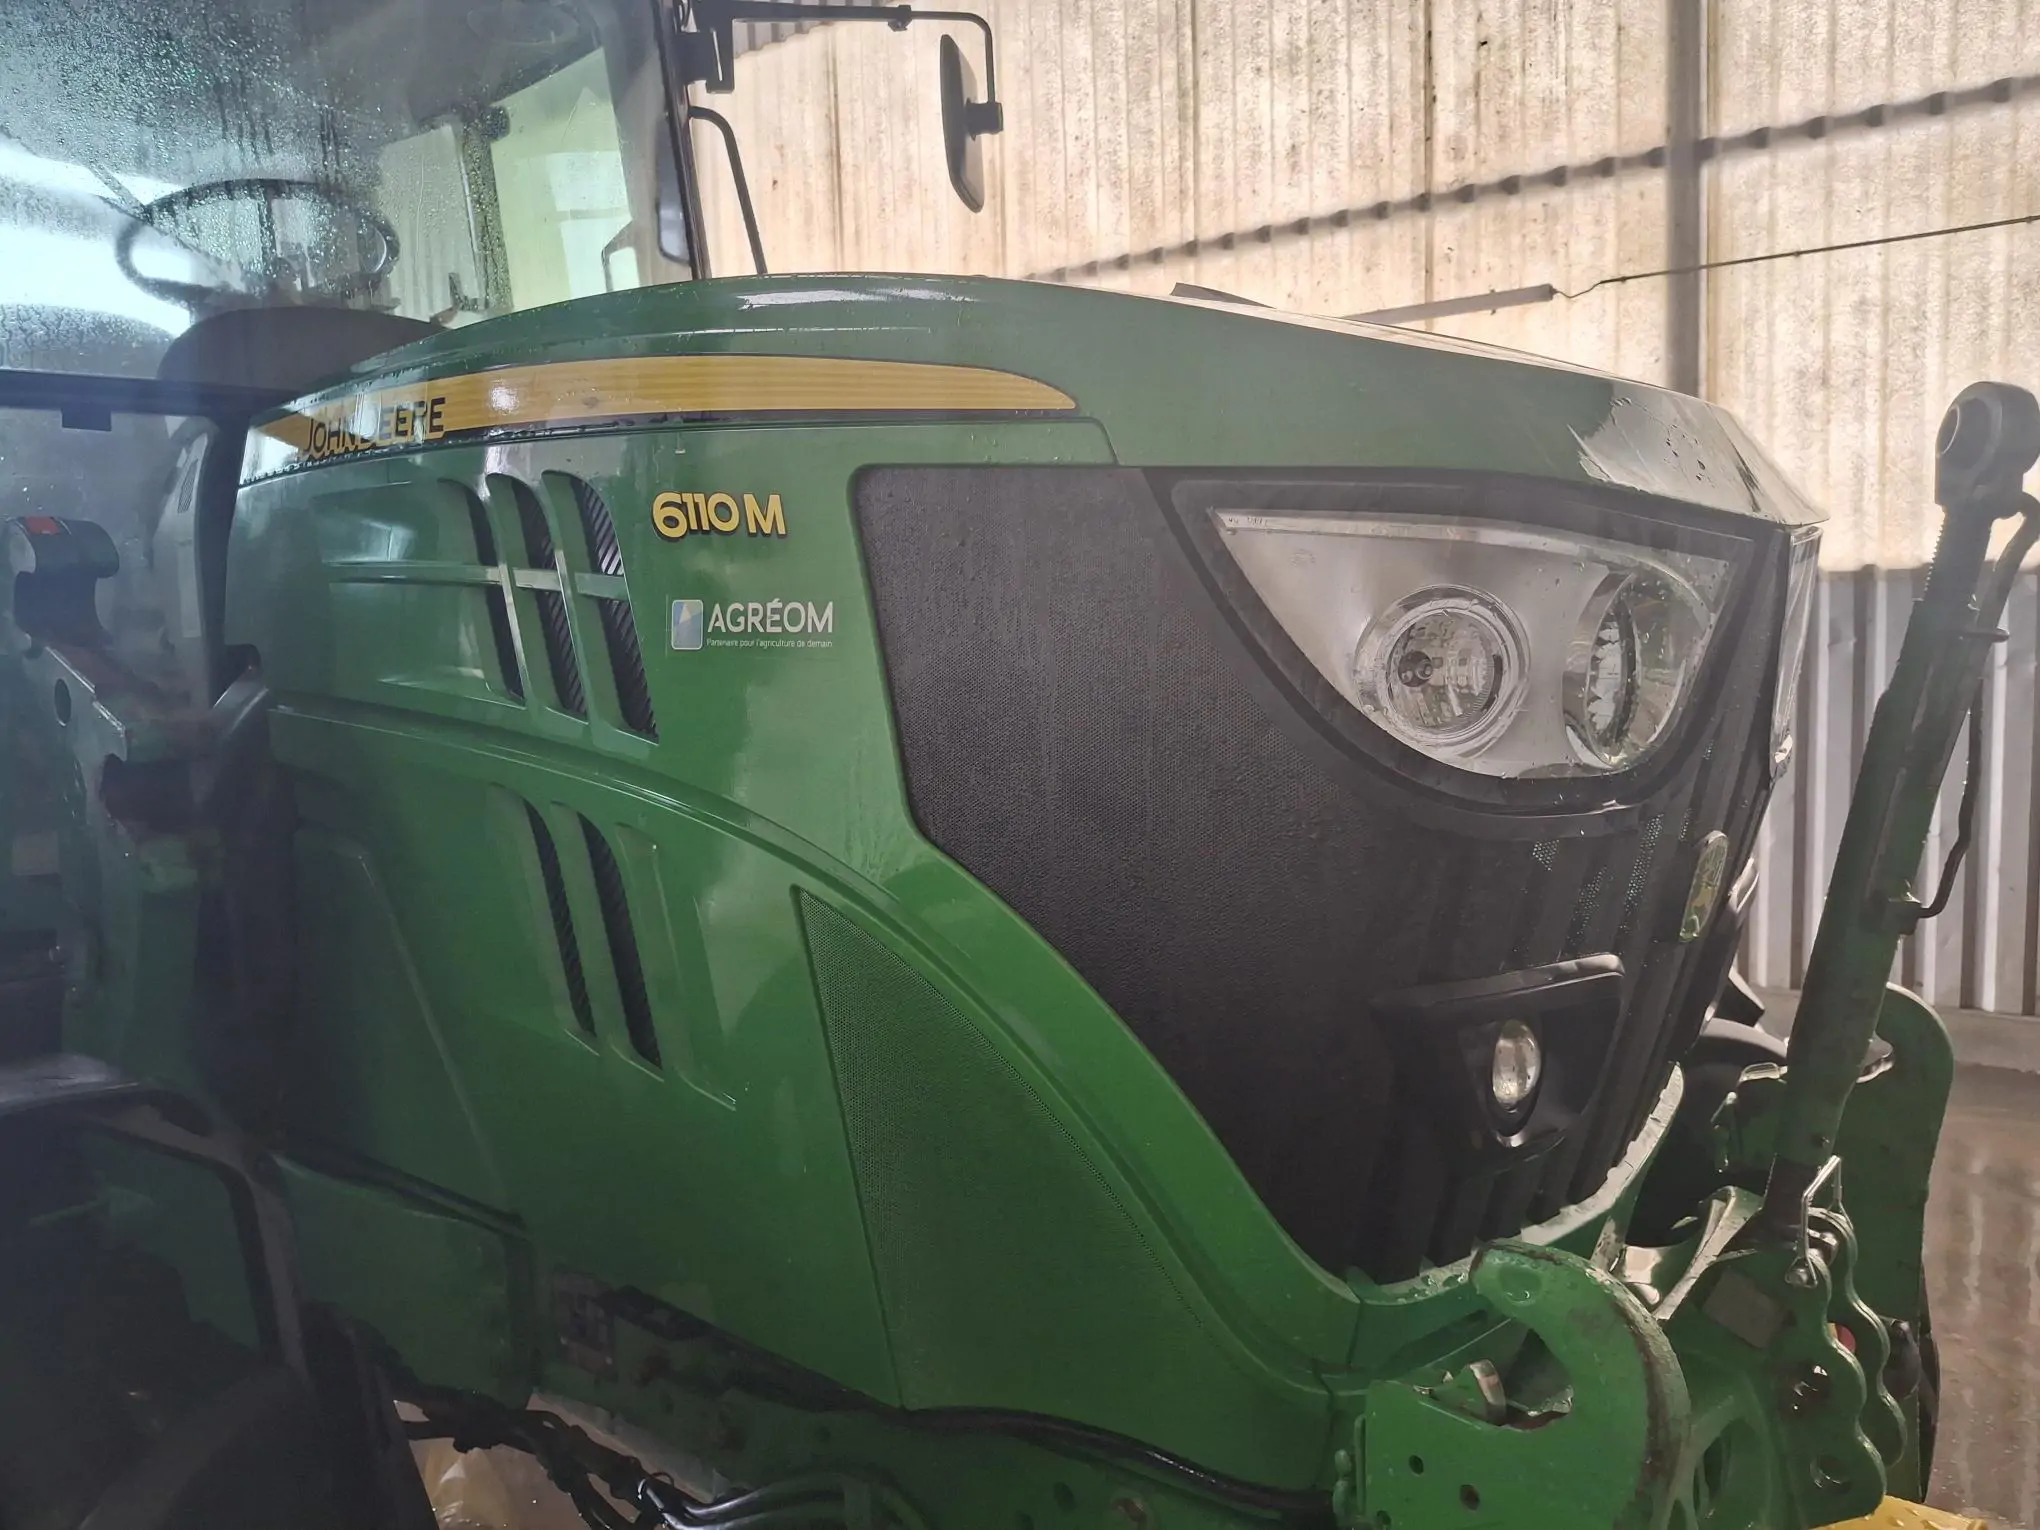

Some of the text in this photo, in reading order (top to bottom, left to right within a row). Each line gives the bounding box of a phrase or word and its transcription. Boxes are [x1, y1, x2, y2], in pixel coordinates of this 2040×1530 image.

[707, 598, 834, 633] AGRÉOM
[706, 638, 833, 650] Partenaire pour l'agriculture de demain
